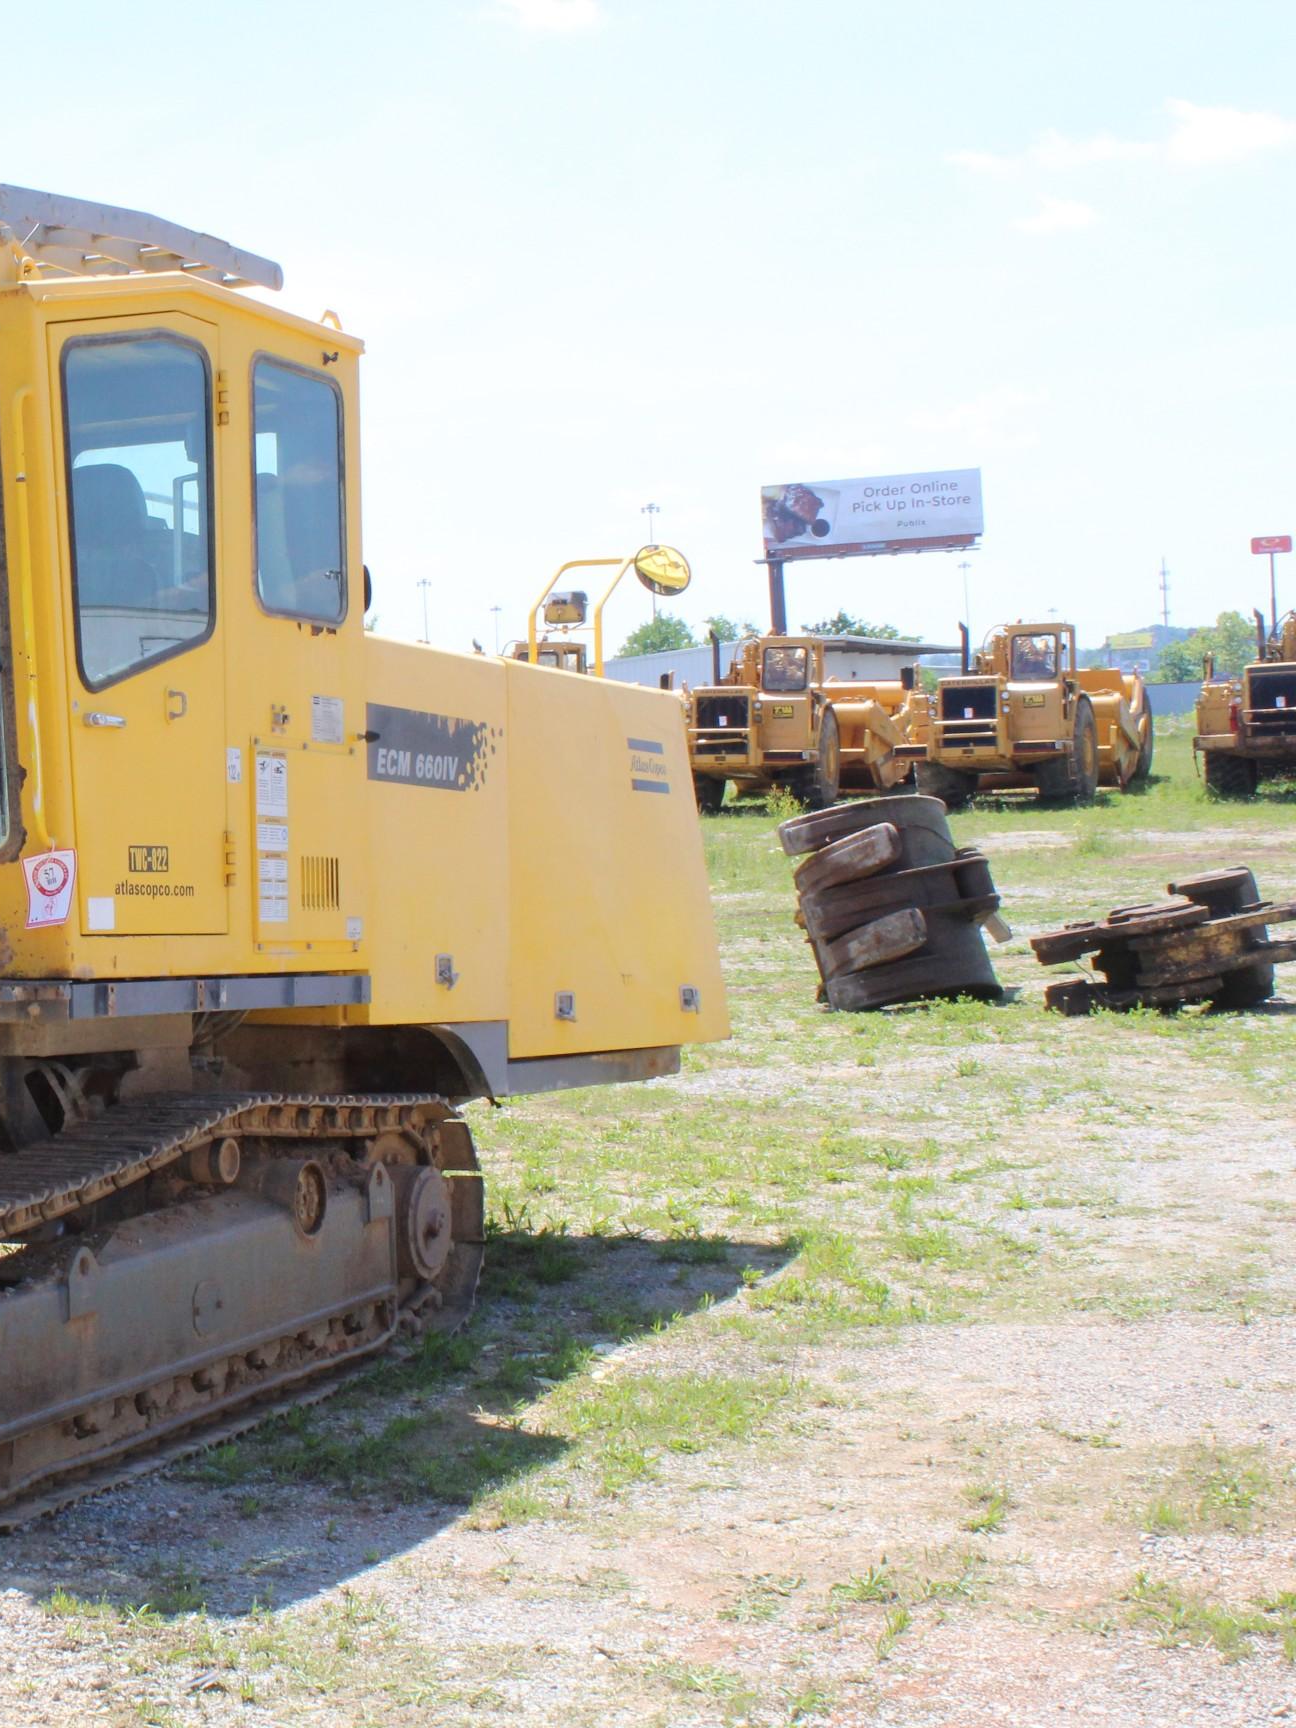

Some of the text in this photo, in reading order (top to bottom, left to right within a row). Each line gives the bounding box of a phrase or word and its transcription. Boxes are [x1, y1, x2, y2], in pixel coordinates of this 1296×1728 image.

[863, 481, 959, 498] Order Online
[852, 495, 972, 513] Pick Up In-Store
[376, 747, 459, 781] ECM 660IV
[129, 846, 168, 872] TWC-822
[114, 879, 195, 901] atlascopco.com
